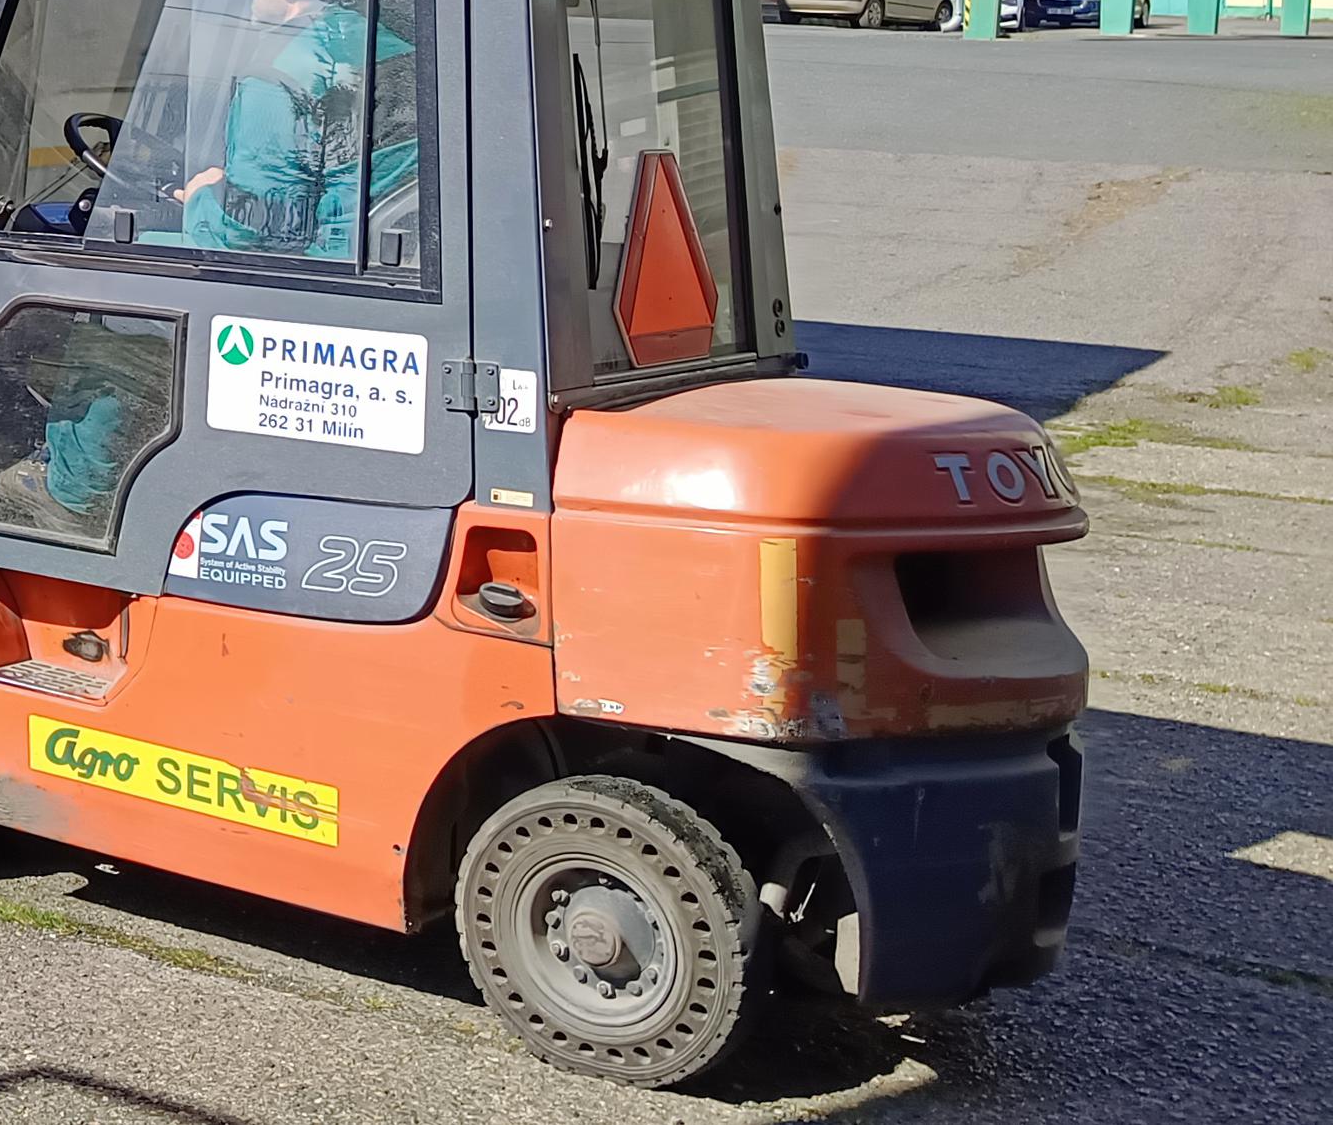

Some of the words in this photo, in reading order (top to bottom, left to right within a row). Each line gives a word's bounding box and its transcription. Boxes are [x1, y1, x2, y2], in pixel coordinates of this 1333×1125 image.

[262, 336, 420, 376] PRIMAGRA
[260, 370, 360, 400] Primagra,
[369, 386, 386, 402] a.
[395, 389, 413, 405] s.
[259, 393, 325, 414] Nádražní
[330, 403, 357, 418] 310
[489, 396, 519, 426] 02
[258, 413, 288, 430] 262
[295, 417, 314, 433] 31
[322, 420, 364, 440] Milín
[200, 513, 289, 562] SAS
[199, 556, 225, 569] System
[225, 559, 234, 570] of
[234, 561, 256, 572] Active
[257, 564, 286, 577] Stability
[199, 567, 287, 591] EQUIPPED
[301, 535, 408, 597] 25
[155, 756, 320, 831] SERVIS
